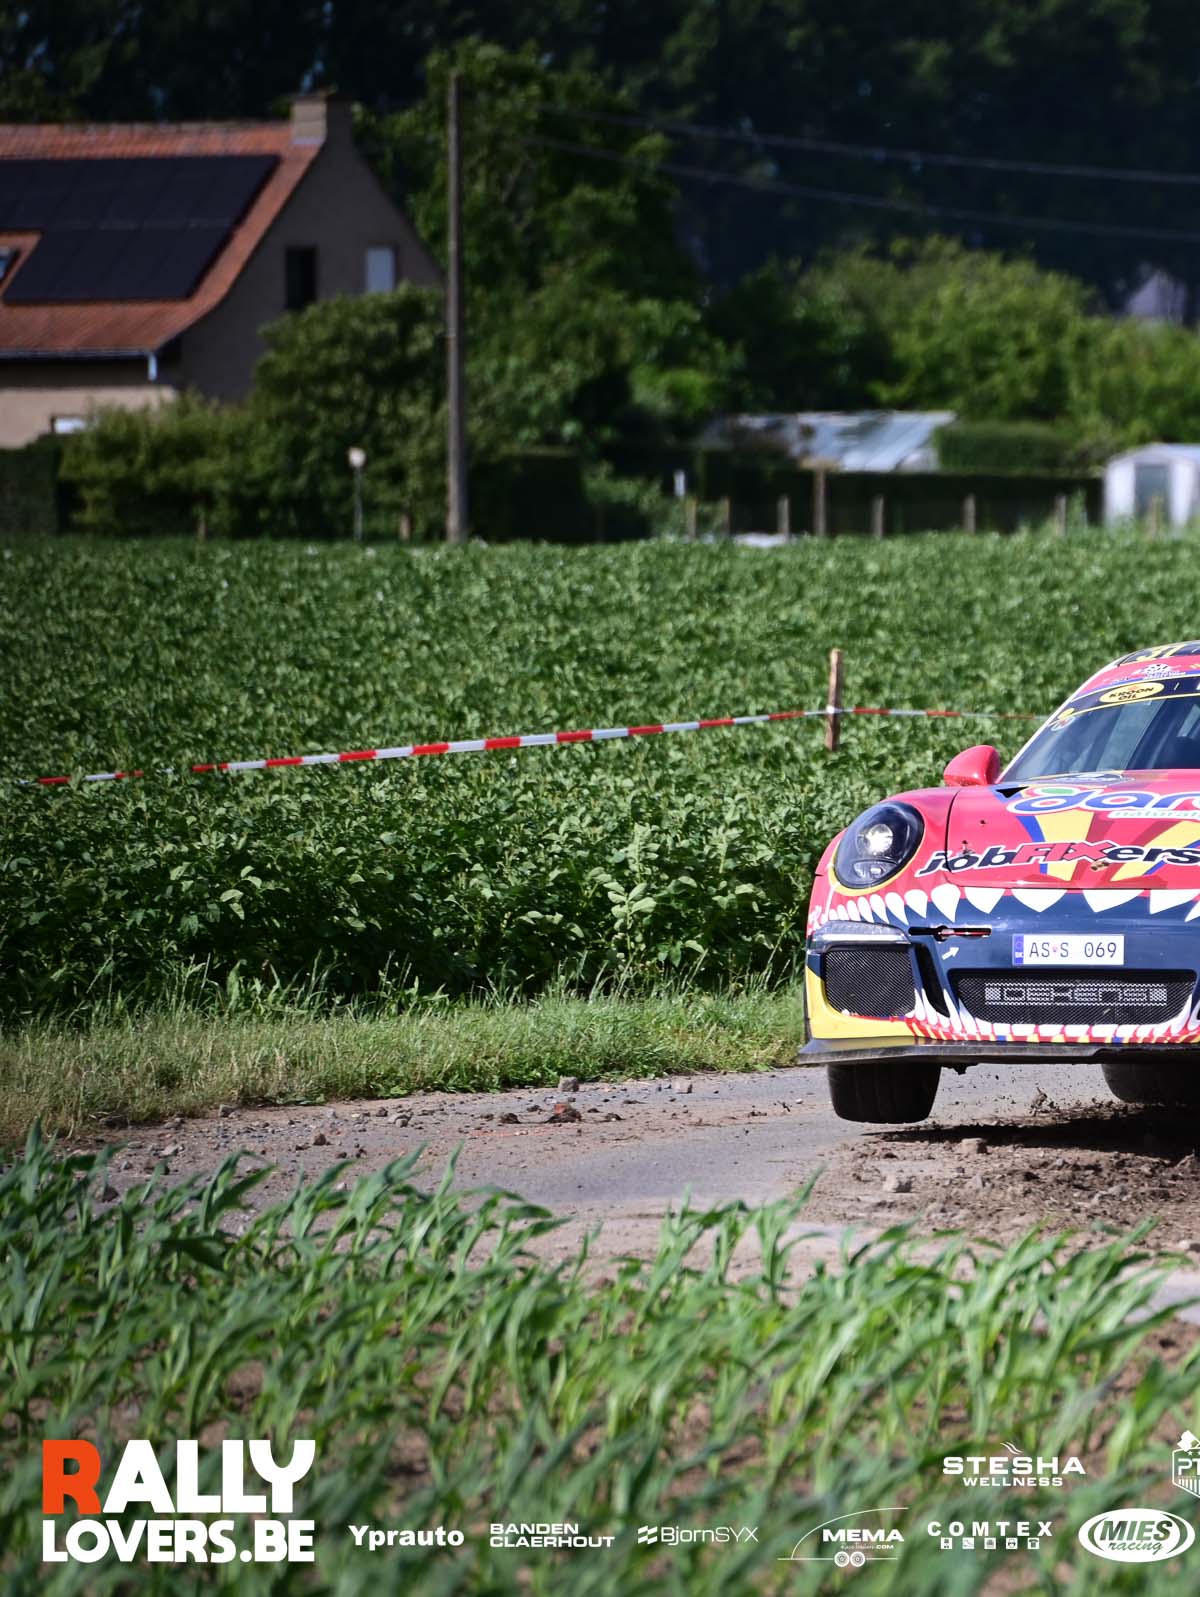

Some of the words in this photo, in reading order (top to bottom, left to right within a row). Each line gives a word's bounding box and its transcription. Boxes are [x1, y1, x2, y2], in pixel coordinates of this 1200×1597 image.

[1108, 686, 1154, 699] KROON
[1118, 693, 1137, 701] OIL
[1084, 942, 1117, 958] 069
